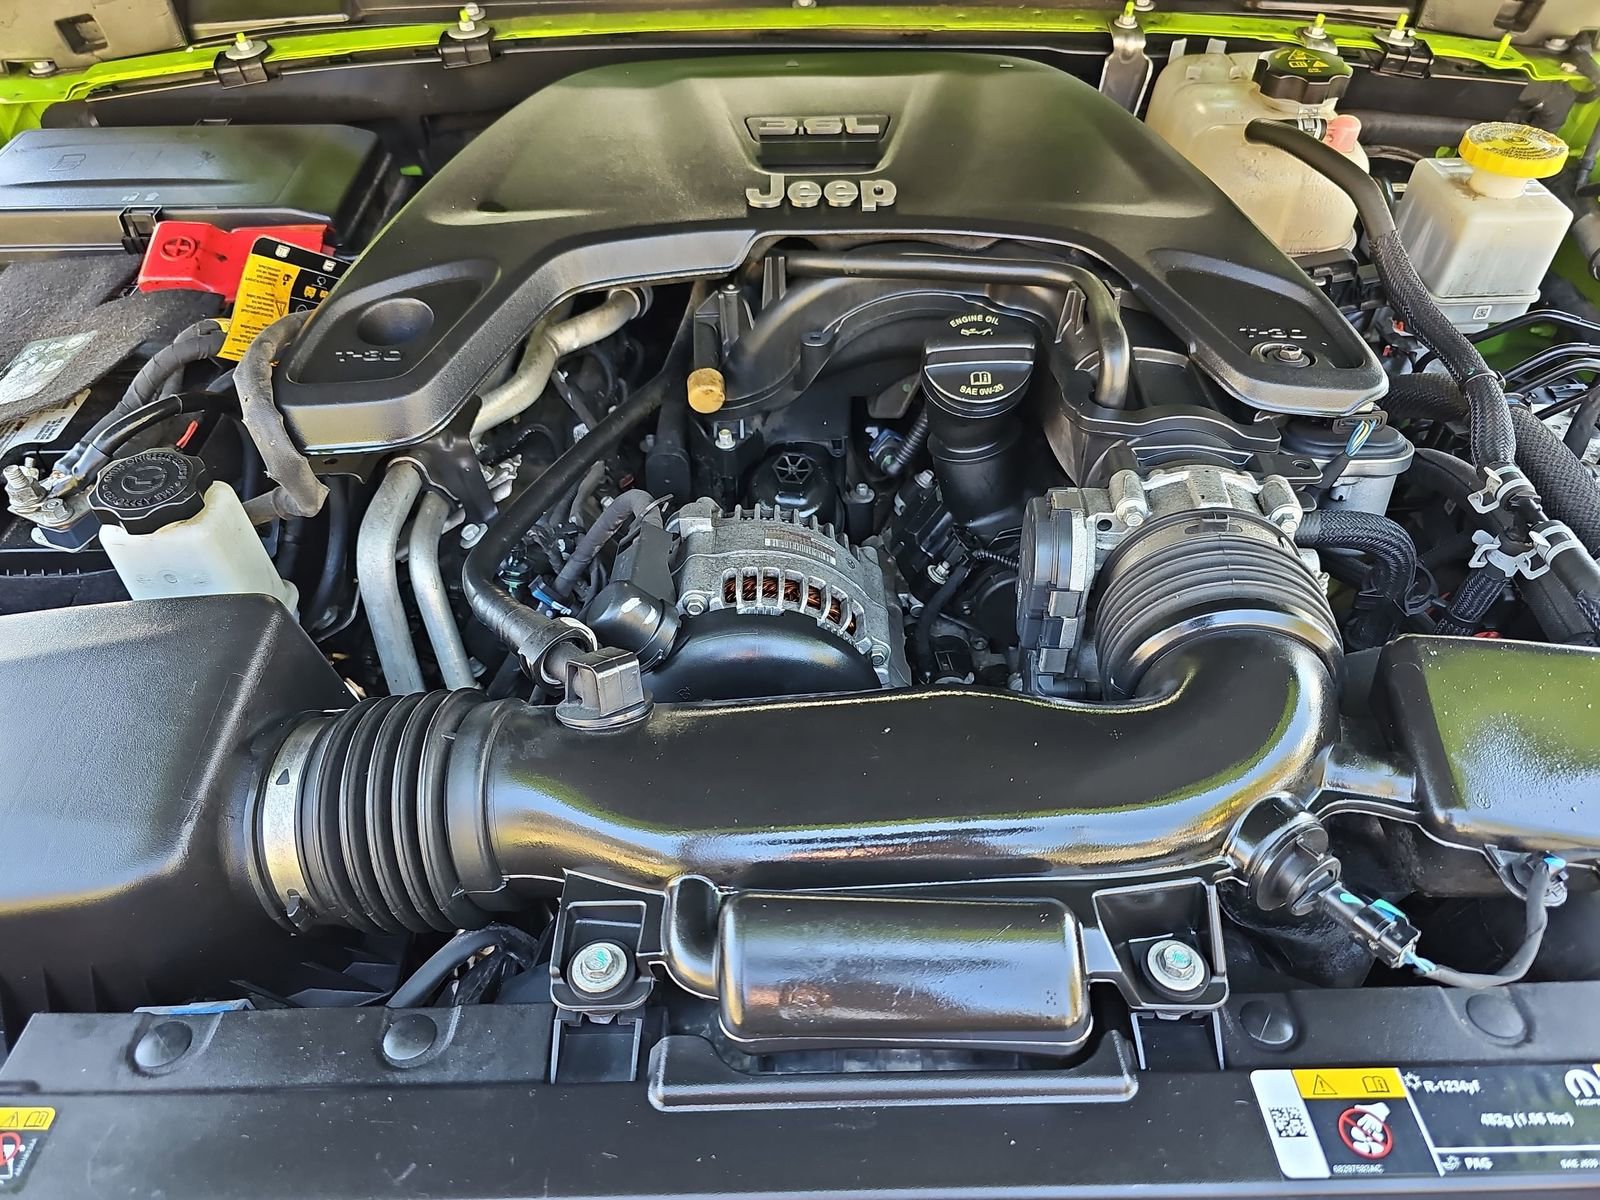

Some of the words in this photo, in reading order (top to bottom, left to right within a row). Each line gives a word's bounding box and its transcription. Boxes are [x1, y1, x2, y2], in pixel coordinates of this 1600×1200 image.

[745, 174, 897, 212] Jeep
[949, 314, 983, 328] ENGINE
[985, 315, 999, 326] OIL
[959, 385, 978, 396] SAE
[979, 383, 1004, 395] 0W-20
[1423, 1079, 1481, 1096] R-1234yf
